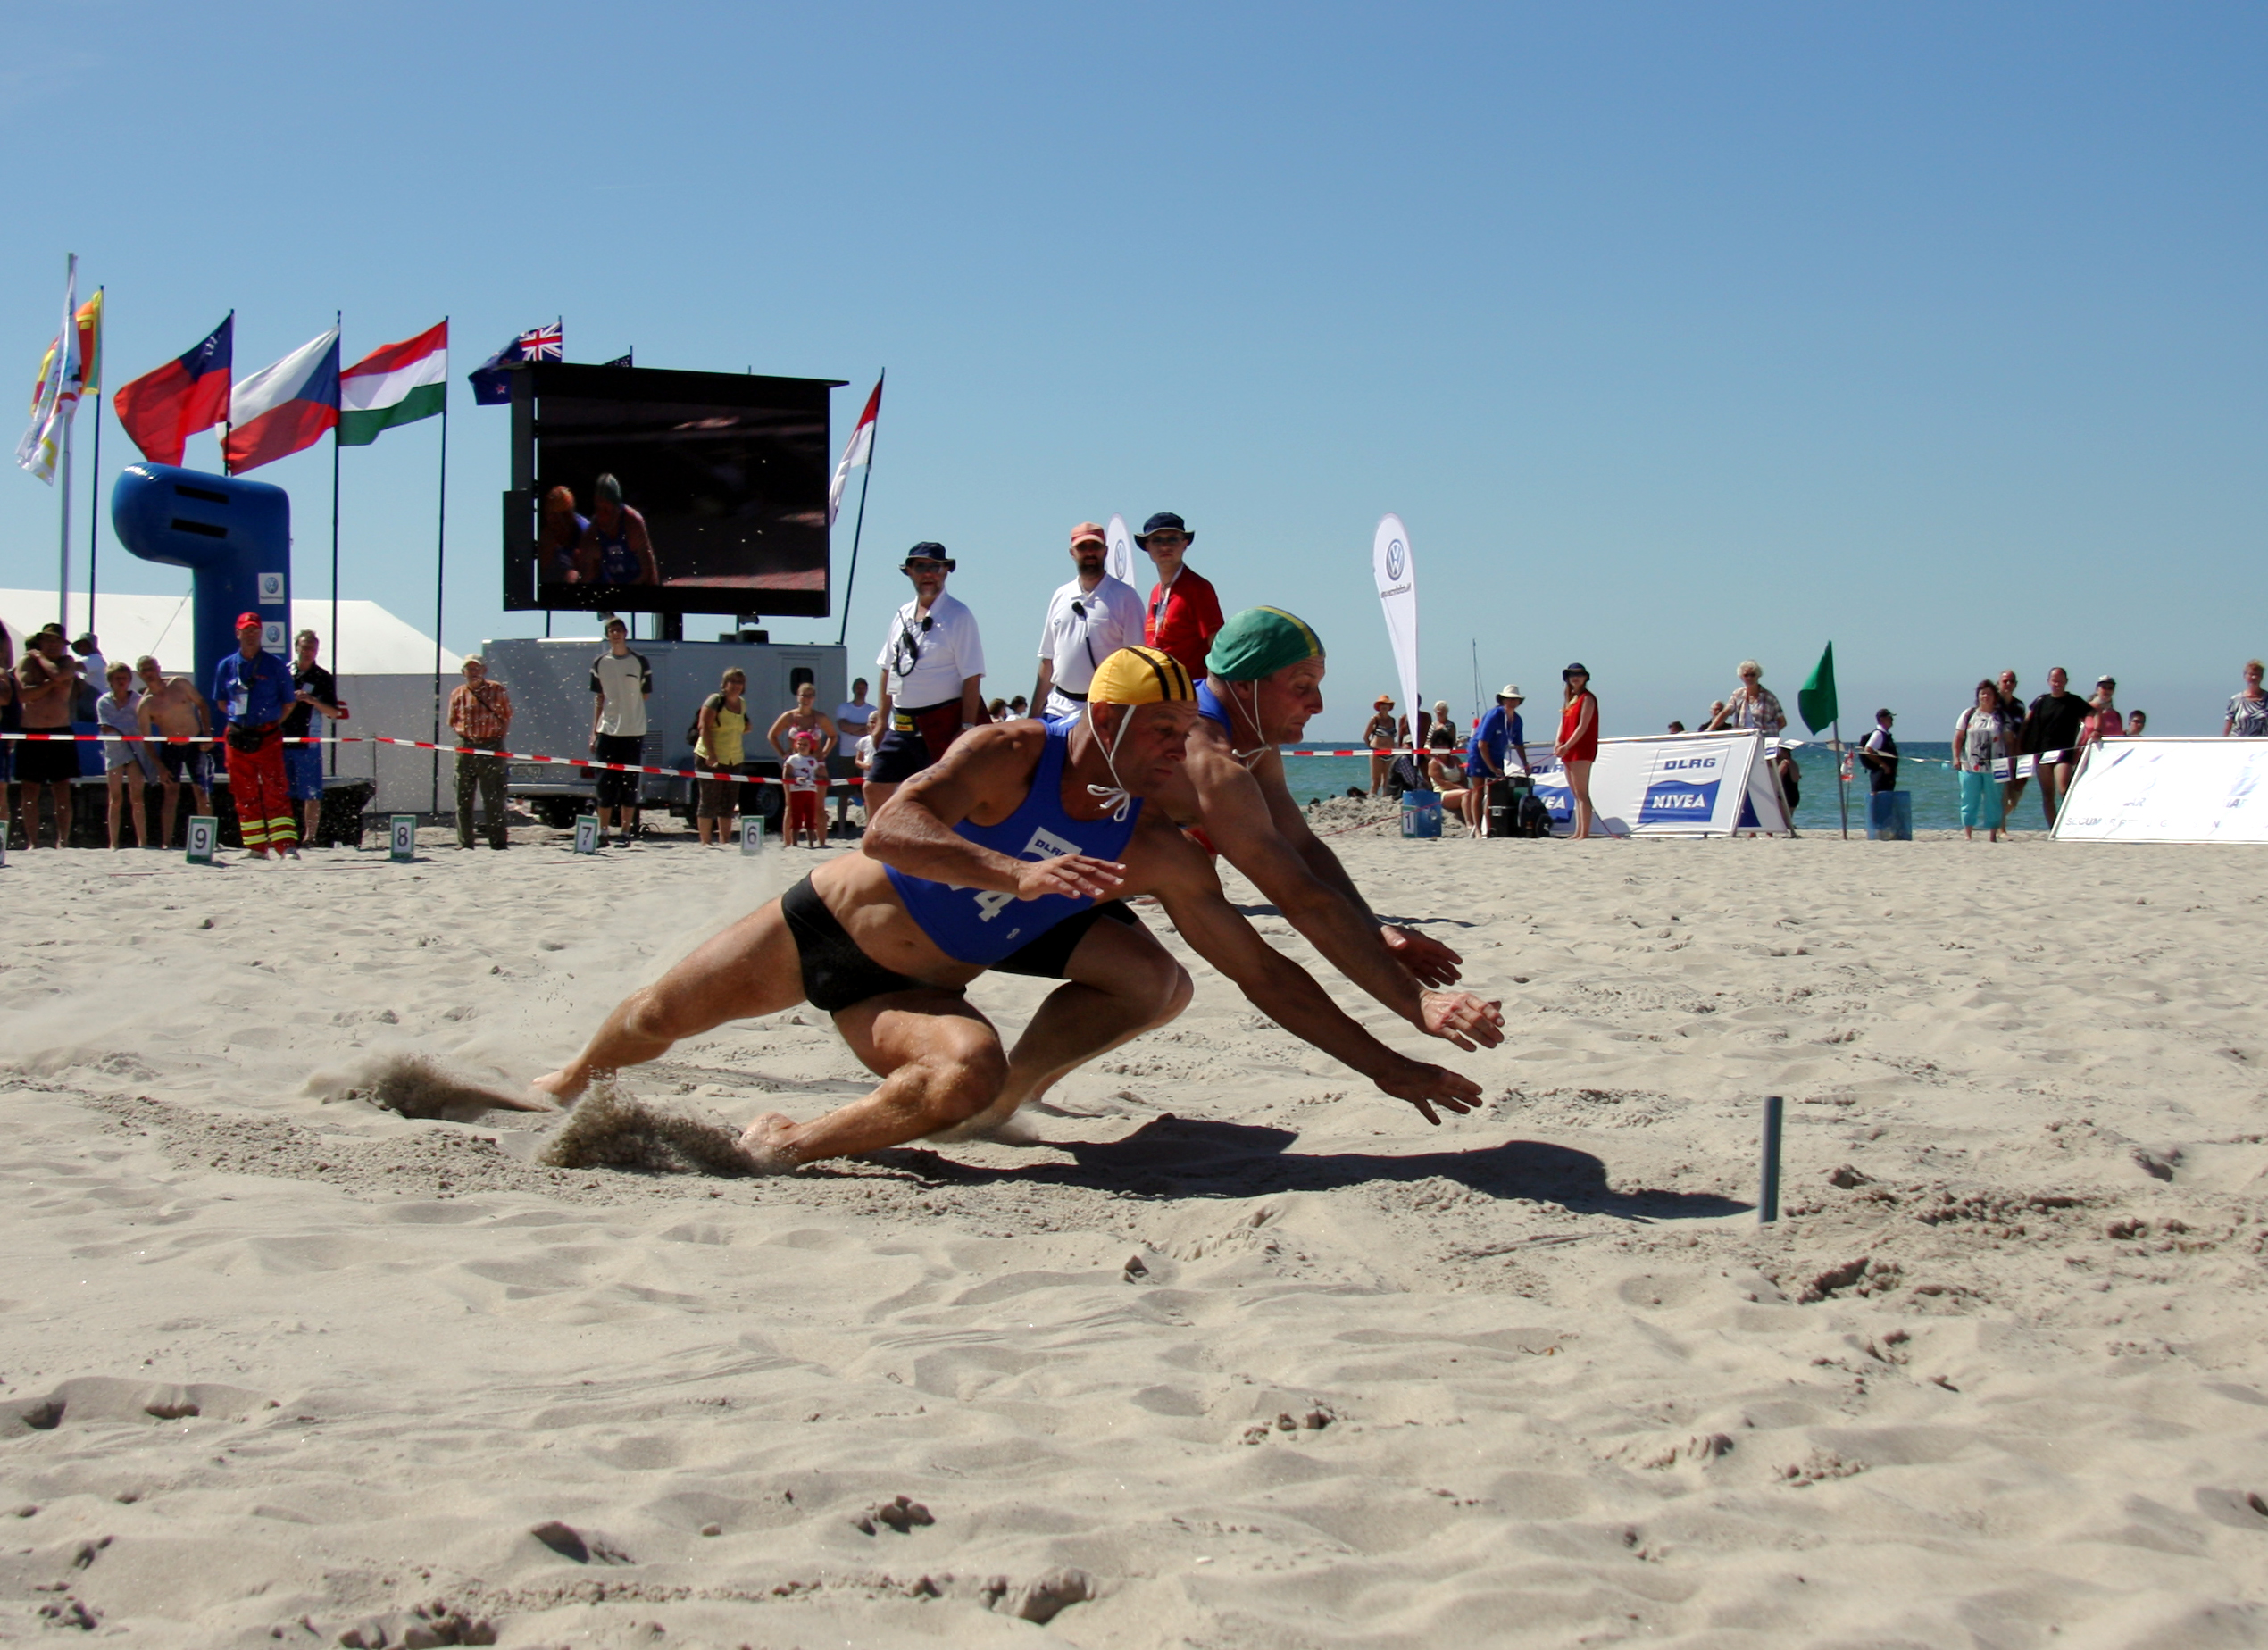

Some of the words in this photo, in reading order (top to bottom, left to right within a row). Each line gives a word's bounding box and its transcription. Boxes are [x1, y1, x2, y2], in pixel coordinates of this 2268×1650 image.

[1531, 765, 1564, 774] DLR
[1664, 758, 1716, 770] DLRG
[1652, 794, 1705, 809] NIVEA
[1405, 812, 1410, 829] 1
[195, 828, 207, 849] 9
[397, 827, 408, 847] 8
[581, 826, 593, 846] 7
[747, 825, 757, 845] 6
